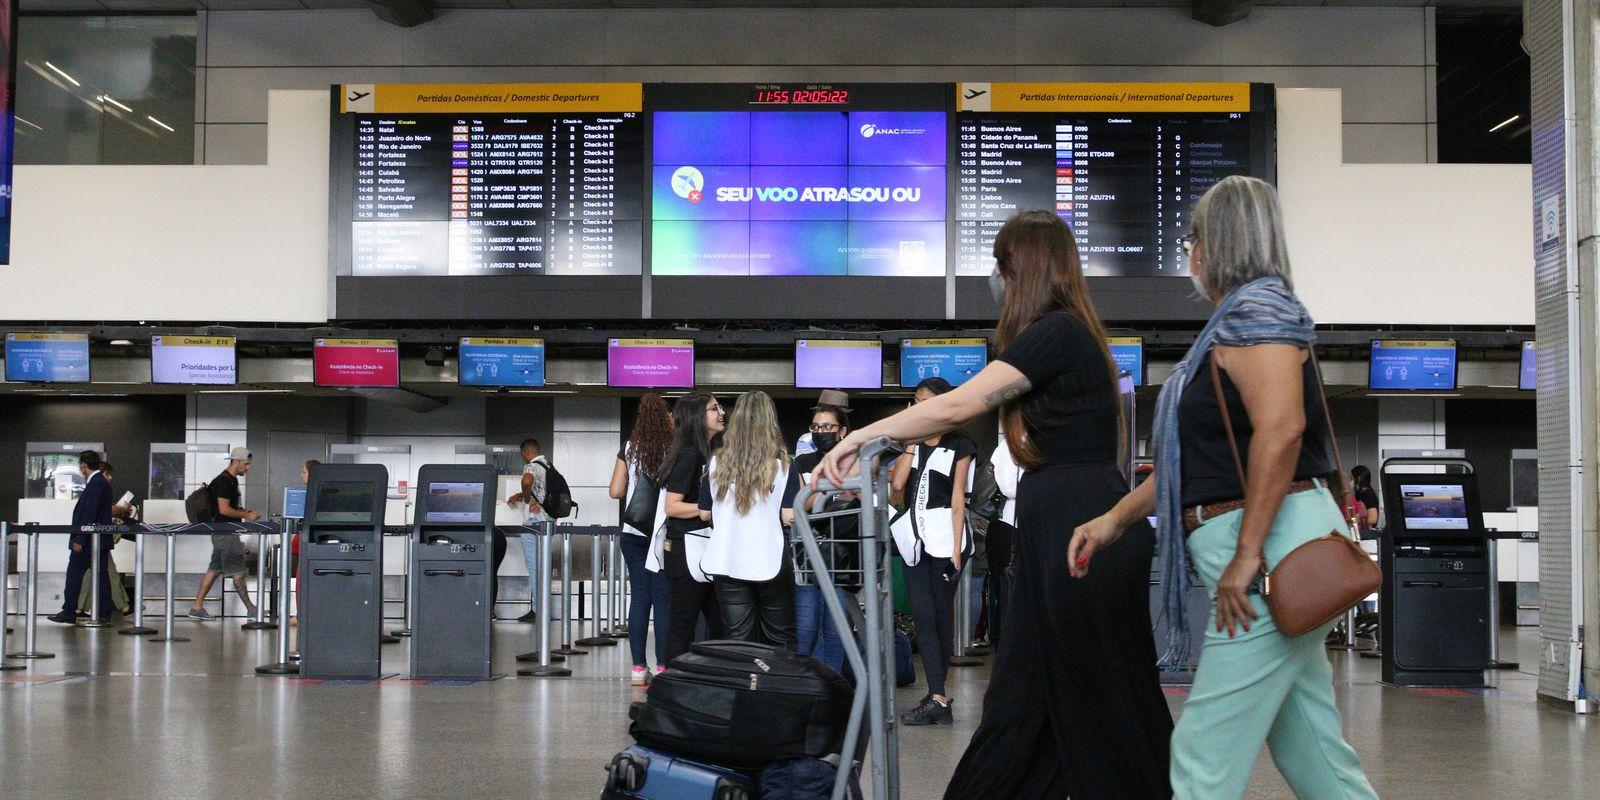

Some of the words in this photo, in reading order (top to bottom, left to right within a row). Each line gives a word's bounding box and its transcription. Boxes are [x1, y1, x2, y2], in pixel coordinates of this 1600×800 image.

[417, 94, 452, 102] Partidas
[454, 93, 502, 102] Domésticas
[512, 93, 549, 102] Domestic
[552, 93, 600, 103] Departures
[759, 91, 789, 102] 11:55
[1020, 93, 1056, 102] Partidas
[1057, 93, 1119, 101] Internacionais
[1128, 93, 1184, 101] International
[1187, 93, 1234, 103] Departures
[716, 188, 752, 201] SEU
[756, 187, 798, 201] VOO
[800, 187, 888, 201] ATRASOU
[892, 187, 920, 201] OU
[918, 473, 927, 510] CHECK-IN
